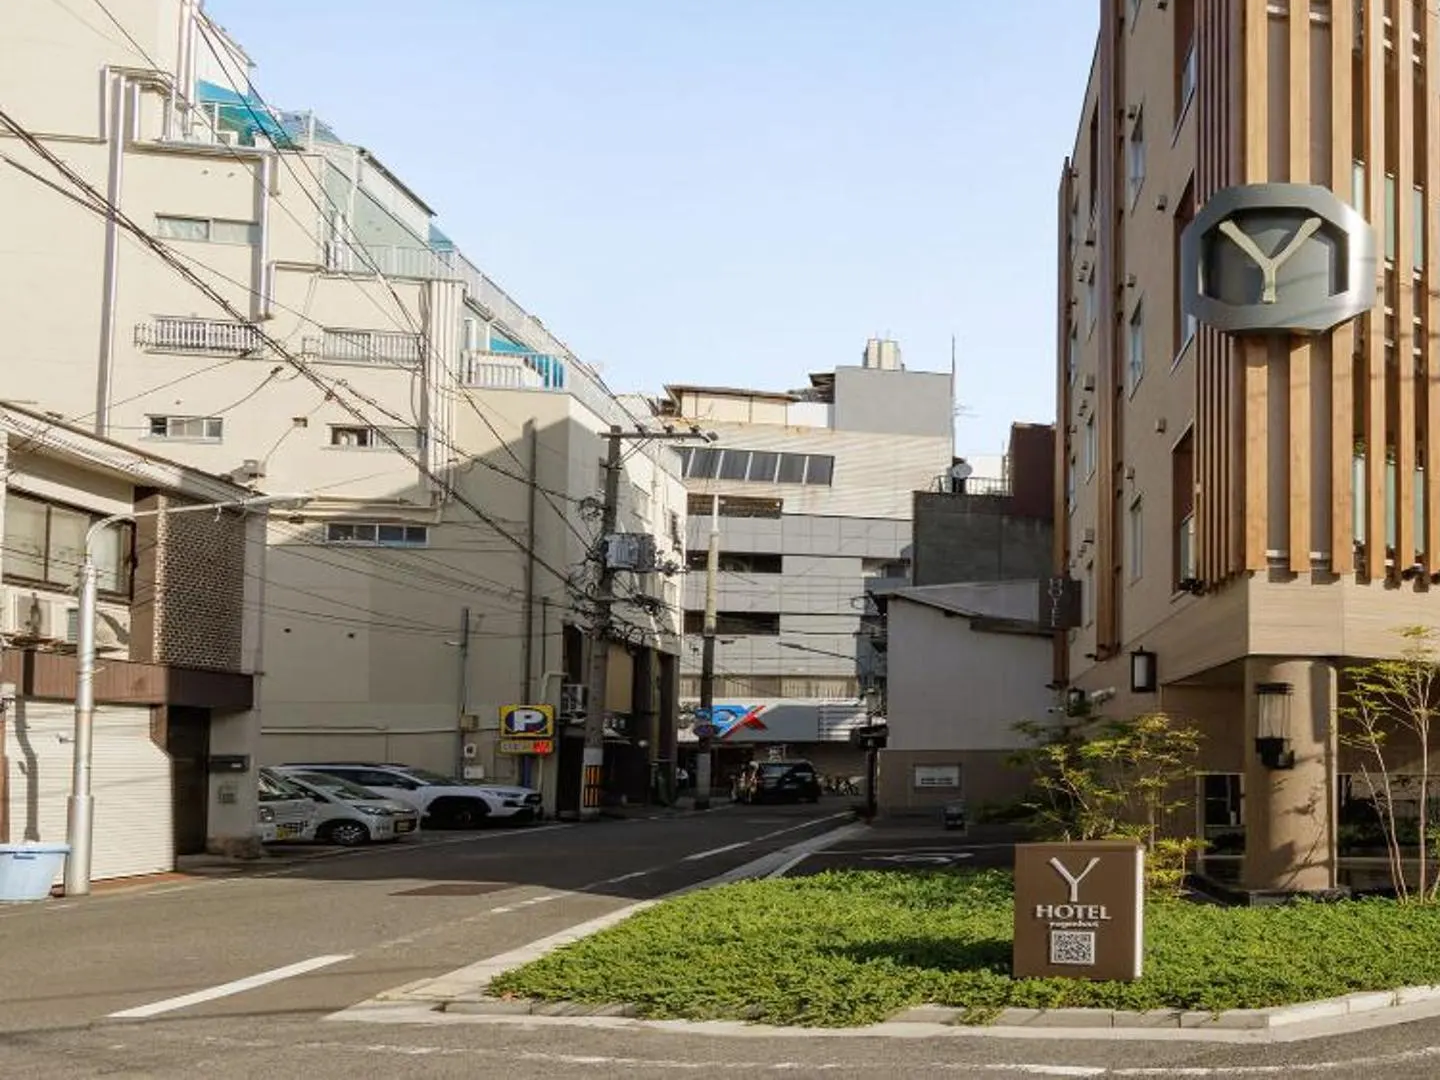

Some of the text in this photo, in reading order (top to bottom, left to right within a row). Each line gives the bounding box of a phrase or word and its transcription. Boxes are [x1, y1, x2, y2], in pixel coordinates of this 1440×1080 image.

[1219, 217, 1322, 304] Y
[514, 710, 543, 731] P
[1050, 857, 1100, 902] Y
[1036, 904, 1112, 920] HOTEL
